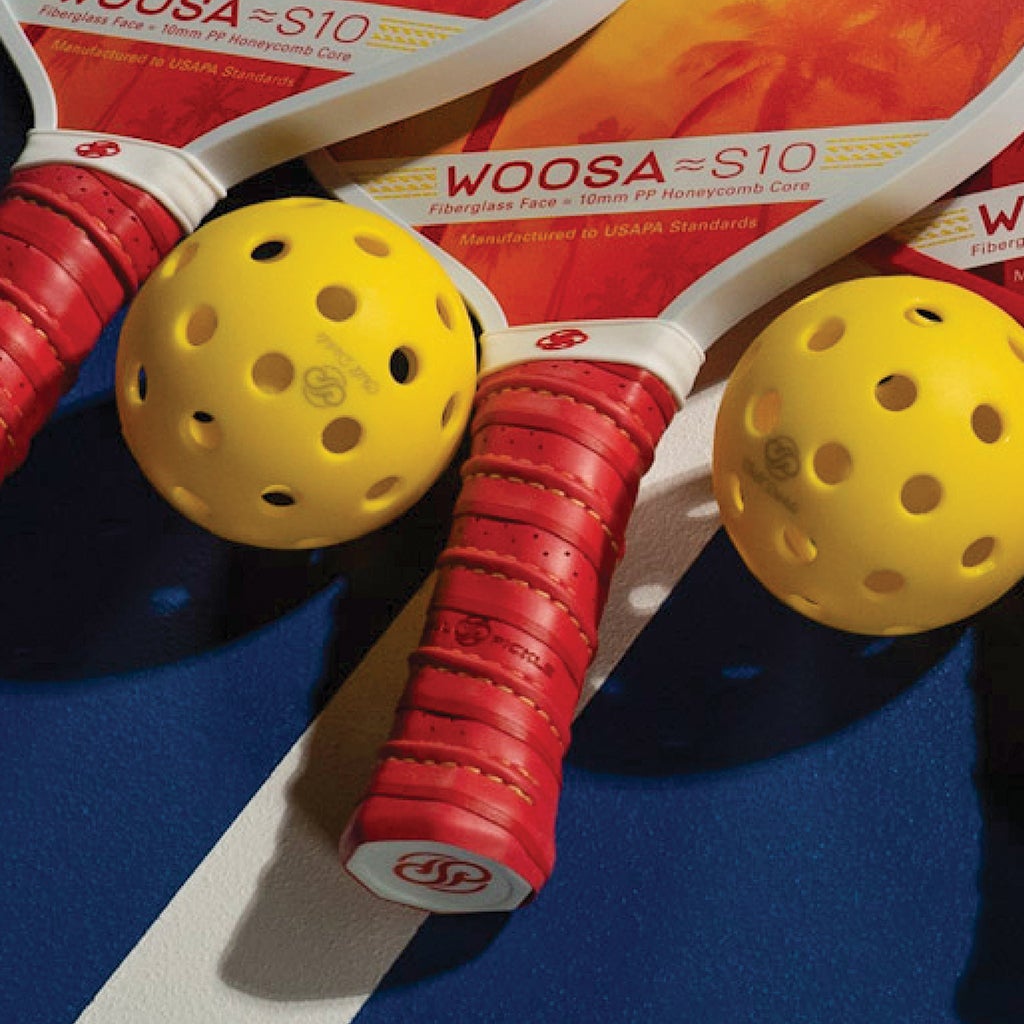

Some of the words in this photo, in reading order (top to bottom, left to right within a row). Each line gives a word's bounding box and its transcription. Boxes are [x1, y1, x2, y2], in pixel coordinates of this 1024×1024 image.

[38, 4, 108, 25] Fiberglass
[112, 16, 144, 30] Face
[162, 23, 202, 39] 10mm
[207, 29, 227, 41] PP
[228, 33, 313, 55] Honeycomb
[316, 46, 352, 62] Core
[447, 150, 666, 197] WOOSA
[428, 201, 514, 215] Fiberglass
[520, 197, 557, 209] Face
[580, 193, 628, 206] 10mm
[635, 189, 656, 201] PP
[662, 182, 764, 200] Honeycomb
[769, 180, 811, 193] Core
[459, 228, 576, 246] Manufactured
[581, 228, 599, 239] to
[605, 221, 663, 237] USAPA
[669, 216, 759, 233] Standards
